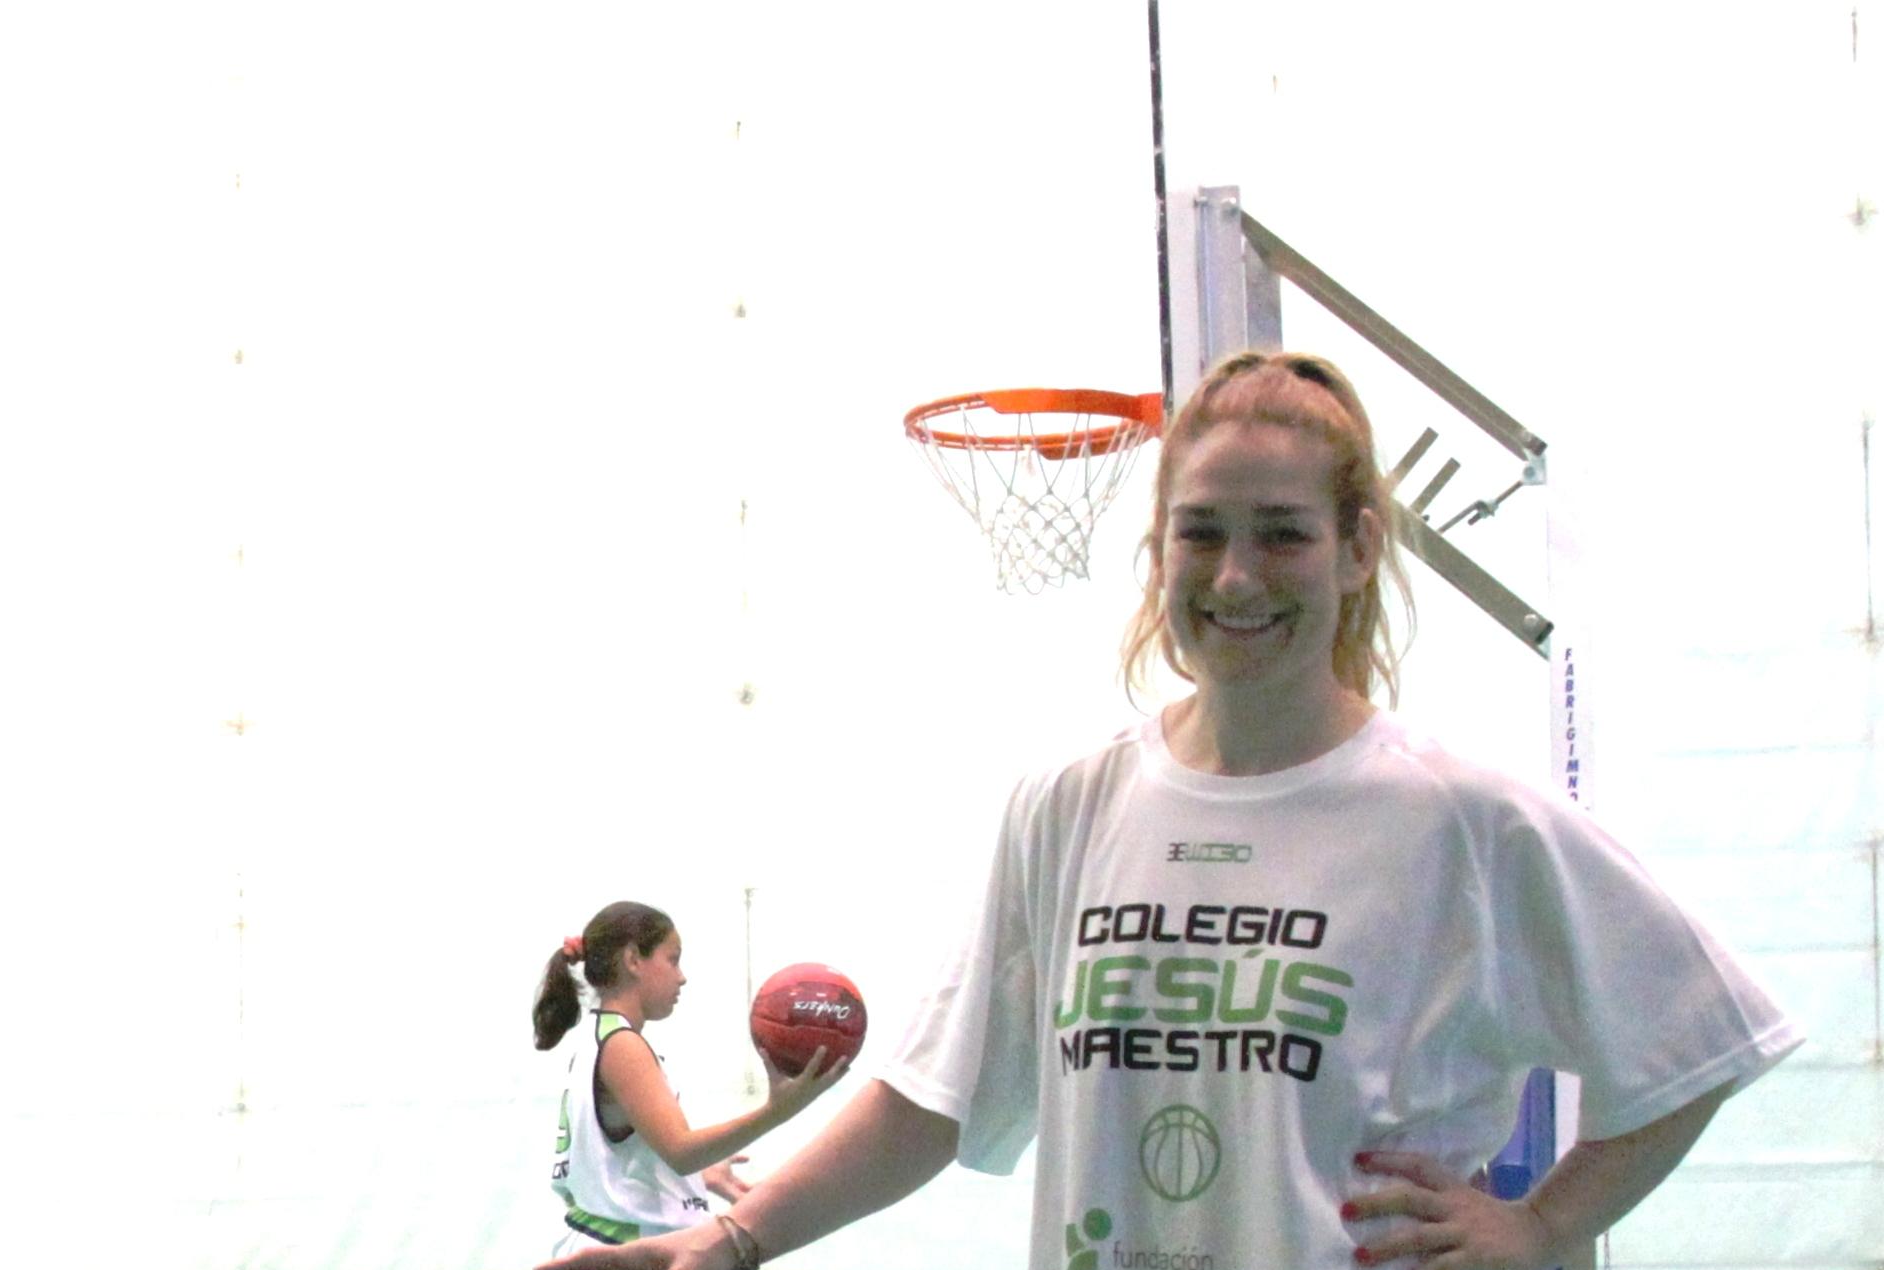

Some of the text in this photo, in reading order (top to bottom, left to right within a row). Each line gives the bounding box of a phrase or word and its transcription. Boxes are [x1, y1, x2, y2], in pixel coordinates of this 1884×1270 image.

[1078, 903, 1329, 949] COLEGIO
[1053, 949, 1355, 1036] JESÚS
[1060, 1027, 1323, 1082] MAESTRO
